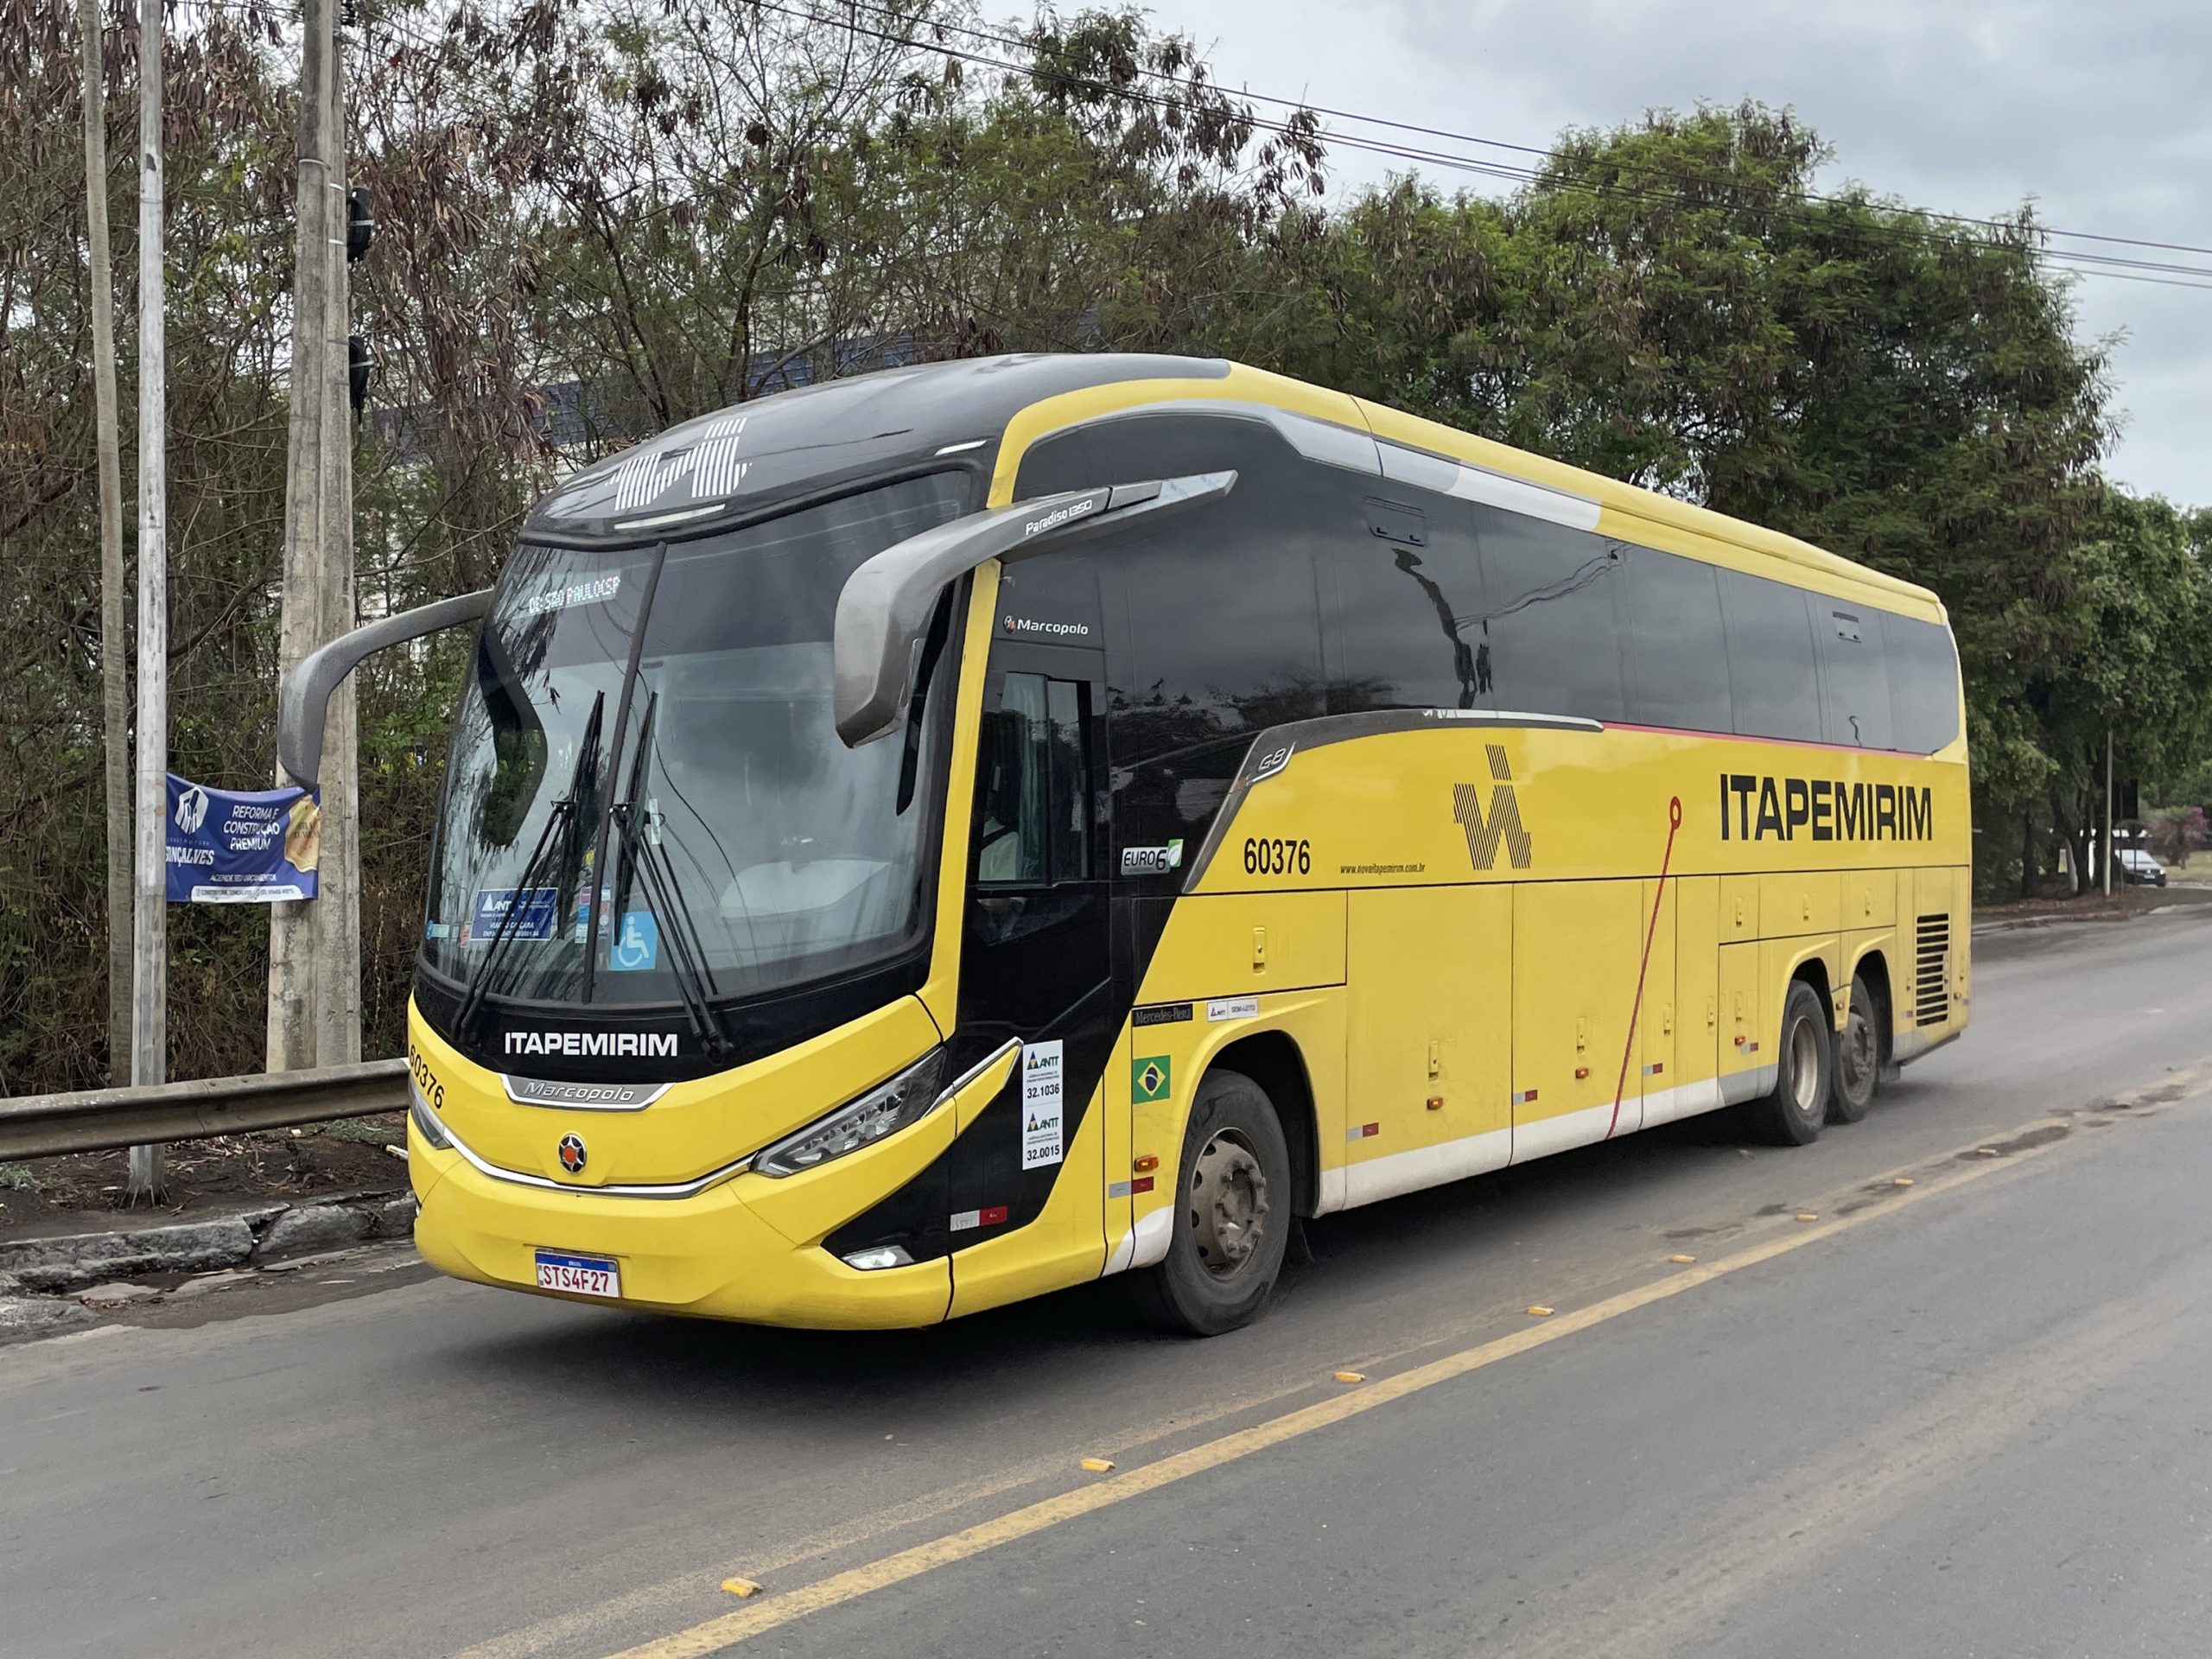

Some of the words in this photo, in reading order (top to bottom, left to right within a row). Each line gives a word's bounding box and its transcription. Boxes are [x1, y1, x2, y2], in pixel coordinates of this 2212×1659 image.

[1026, 510, 1068, 536] Paradiso
[1069, 499, 1093, 518] 1350
[1017, 619, 1089, 636] Marcopolo
[1257, 747, 1287, 772] G8
[232, 805, 272, 820] REFORMA
[271, 808, 280, 820] E
[1720, 773, 1933, 842] ITAPEMIRIM
[223, 819, 280, 838] CONSTRUÇÃO
[230, 837, 271, 851] PREMIUM
[1243, 837, 1311, 875] 60376
[1340, 862, 1426, 875] www.novaitapemirim.com.br
[505, 1032, 678, 1057] ITAPEMIRIM
[1039, 1055, 1059, 1069] ANTT
[410, 1044, 445, 1109] 60376
[523, 1081, 635, 1103] Marcopolo
[1027, 1083, 1060, 1099] 32.1036
[1039, 1116, 1059, 1130] ANTT
[1027, 1144, 1060, 1161] 32.0015
[543, 1264, 609, 1293] STS4F27
